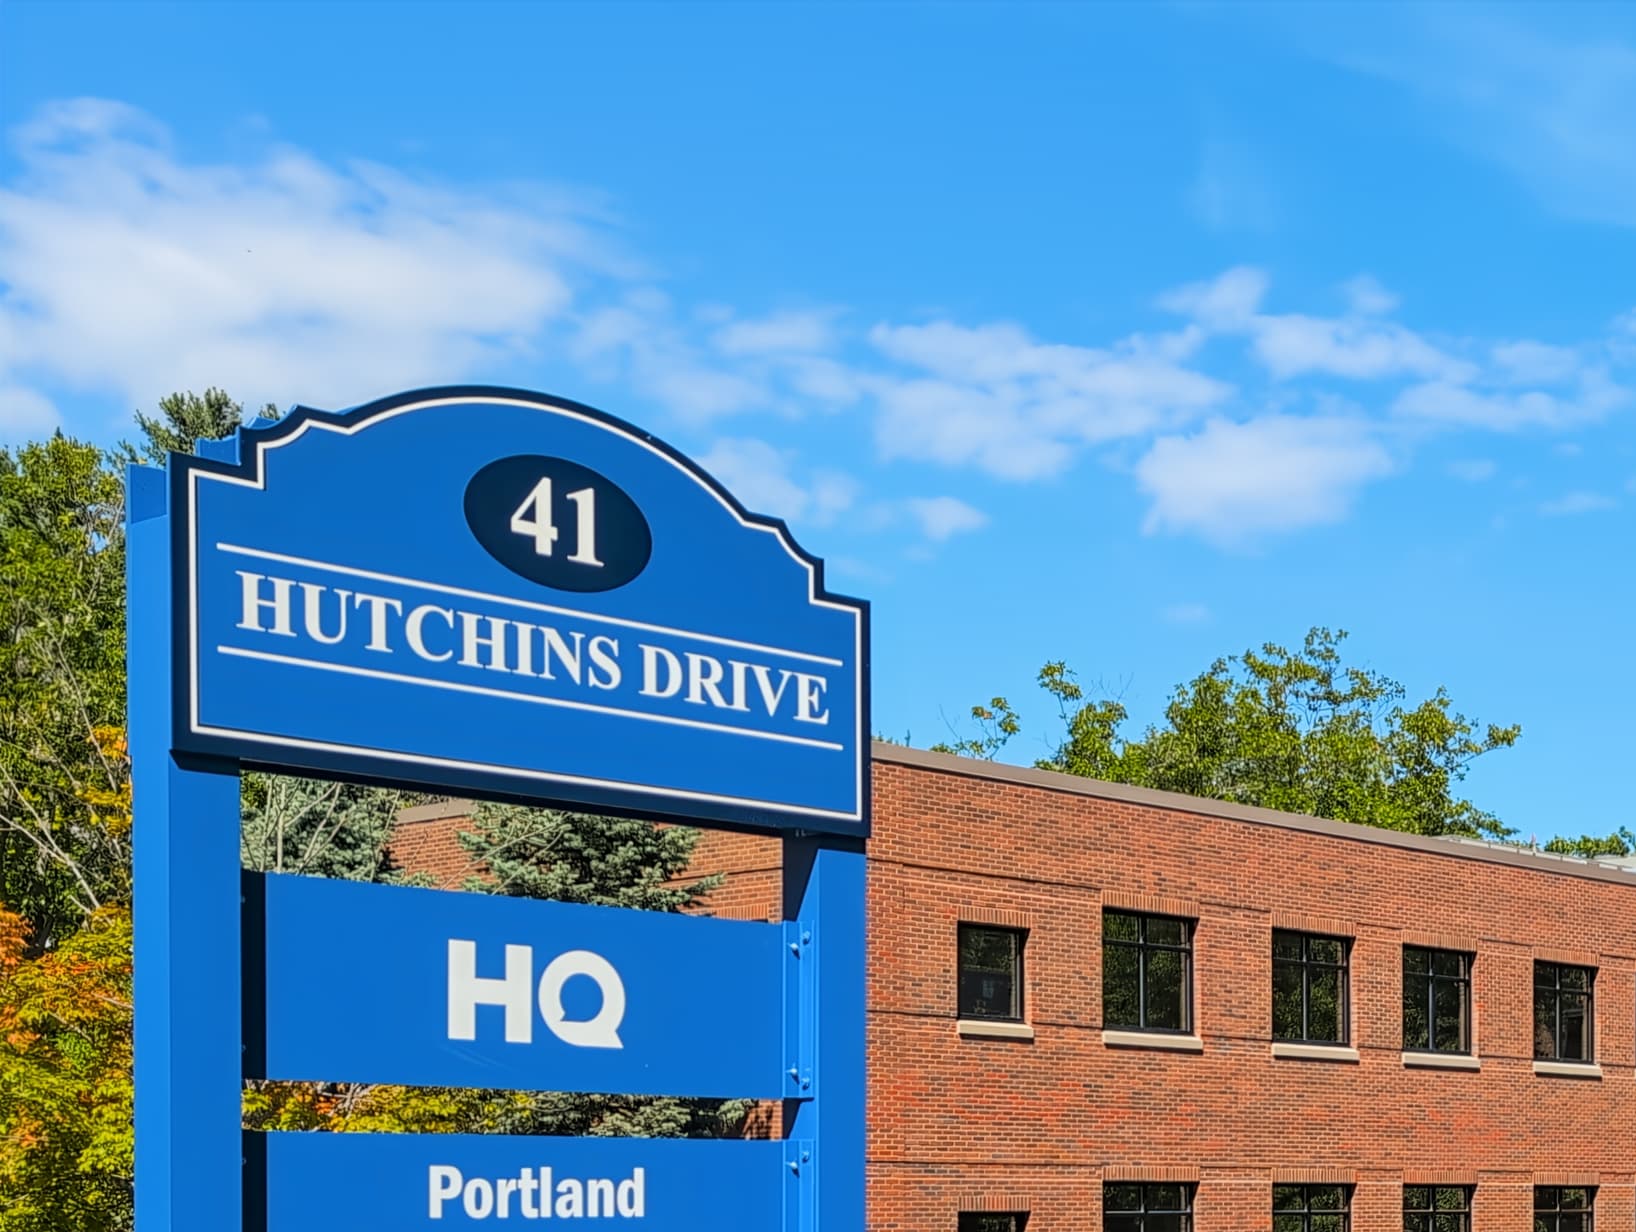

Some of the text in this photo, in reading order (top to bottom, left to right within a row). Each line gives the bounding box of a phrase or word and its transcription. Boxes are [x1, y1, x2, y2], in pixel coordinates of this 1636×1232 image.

[510, 476, 605, 567] 41
[235, 570, 830, 726] HUTCHINS DRIVE
[447, 938, 626, 1049] HQ
[428, 1164, 645, 1219] Portland
